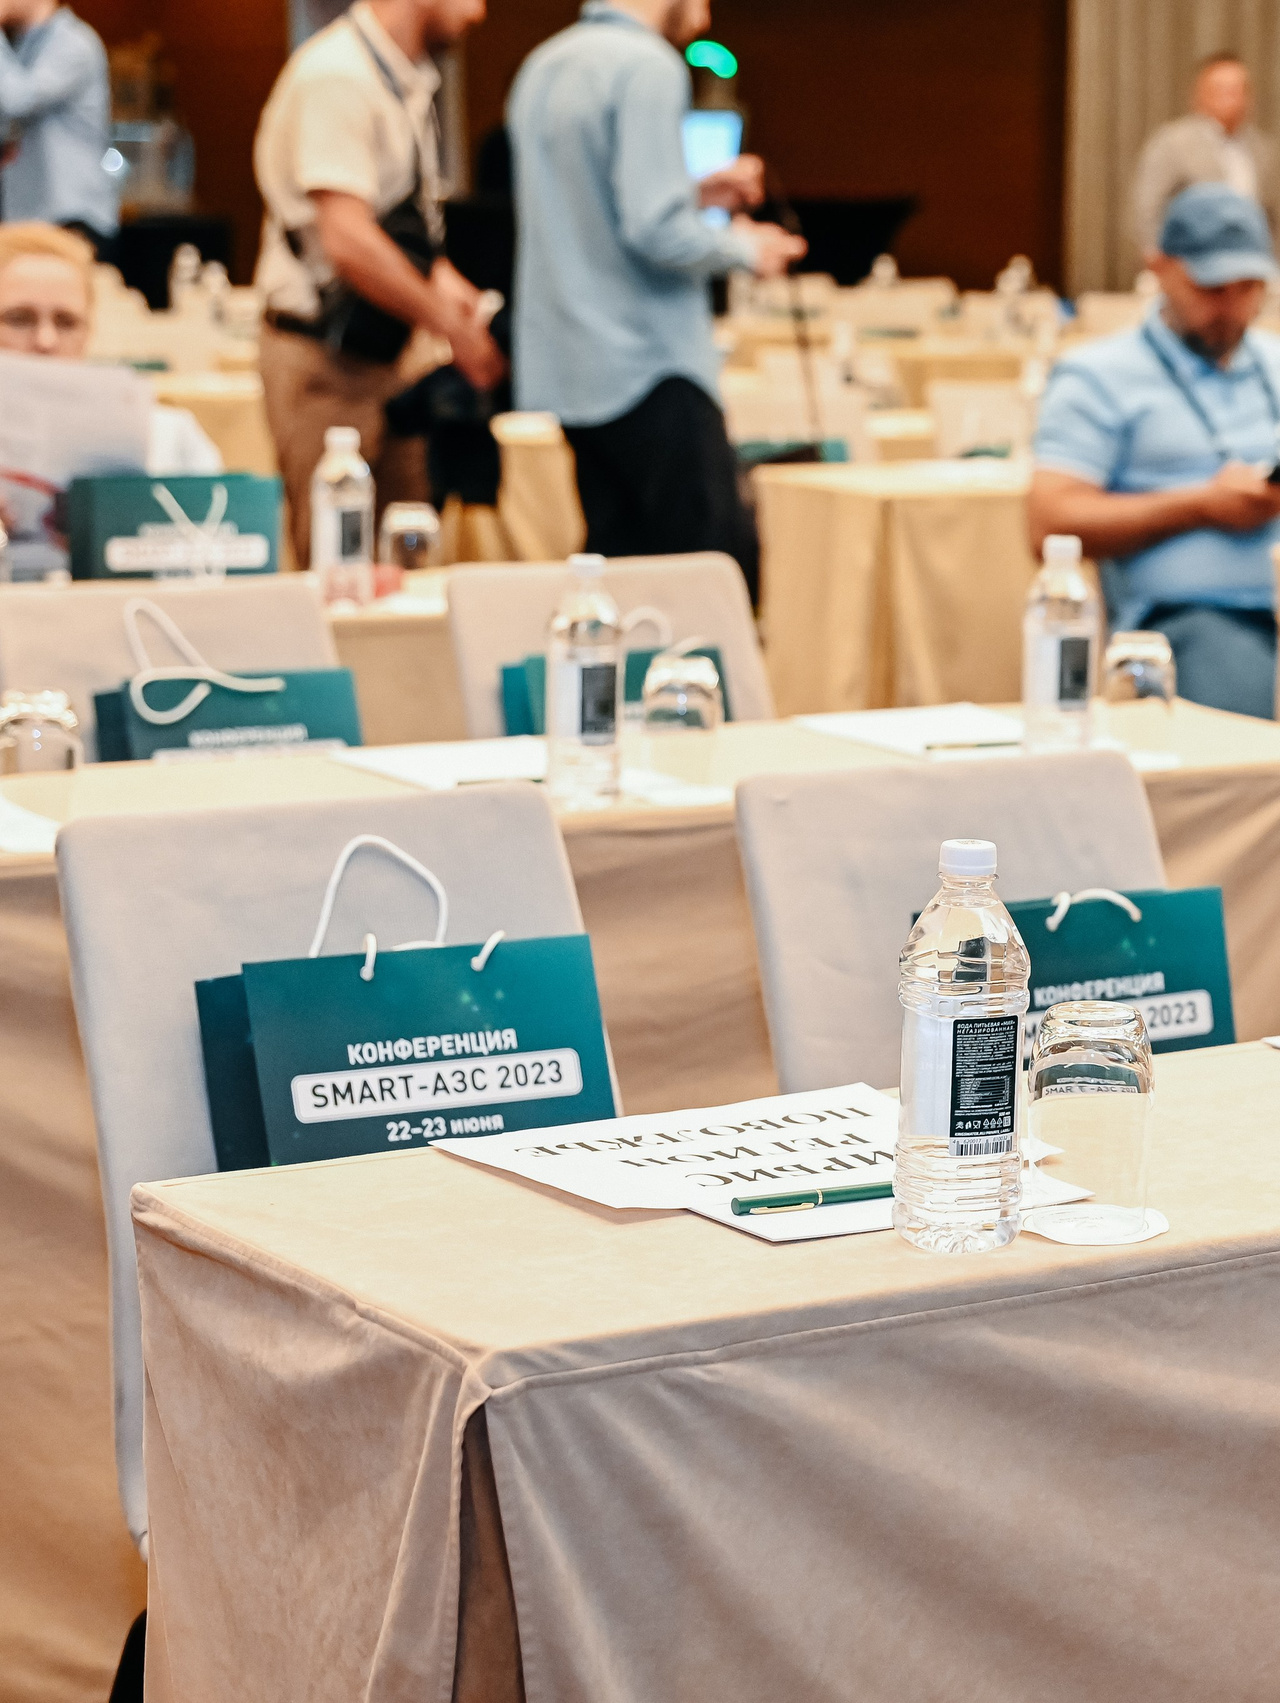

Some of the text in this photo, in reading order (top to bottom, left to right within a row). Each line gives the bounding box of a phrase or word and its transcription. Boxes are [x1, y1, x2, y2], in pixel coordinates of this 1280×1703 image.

[1033, 971, 1166, 1008] КОНФЕРЕНЦИЯ
[1148, 1001, 1198, 1029] 2023
[347, 1028, 518, 1066] КОНФЕРЕНЦИЯ
[312, 1060, 564, 1109] SMART-АЗС 2023
[386, 1115, 505, 1142] 22-23 июня
[513, 1107, 874, 1158] ПОВОЛЖЬЕ
[618, 1132, 872, 1169] РЕГИОН
[684, 1149, 895, 1187] ИРБИС
